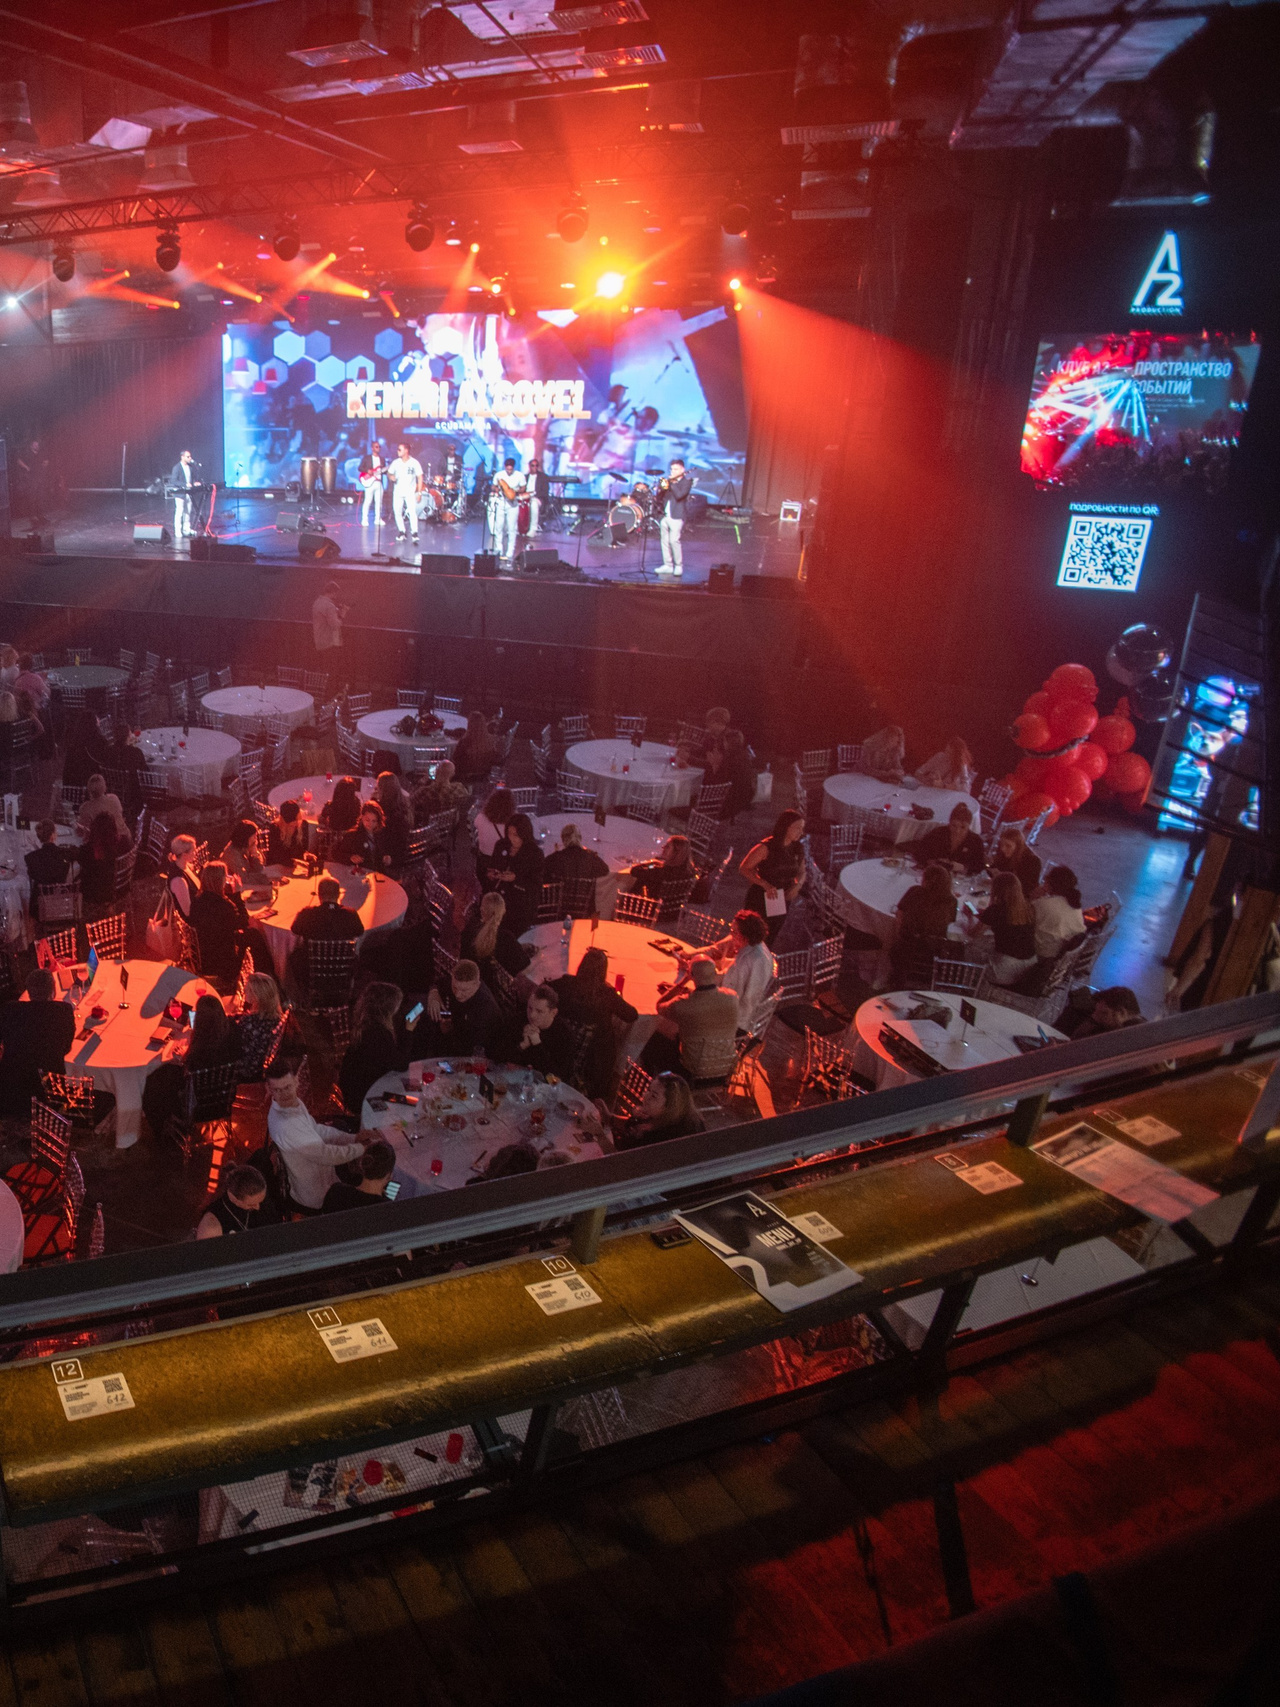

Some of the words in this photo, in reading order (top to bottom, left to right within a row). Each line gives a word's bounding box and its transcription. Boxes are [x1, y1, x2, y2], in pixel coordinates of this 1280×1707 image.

[1130, 306, 1181, 314] PRODUCTION
[1056, 361, 1090, 375] КЛУБ
[1133, 361, 1233, 377] ПРОСТРАНСТВО
[1142, 503, 1159, 515] QR
[755, 1225, 796, 1248] MENU
[548, 1259, 567, 1271] 10
[314, 1310, 332, 1324] 11
[56, 1363, 77, 1377] 12
[106, 1393, 126, 1405] 612
